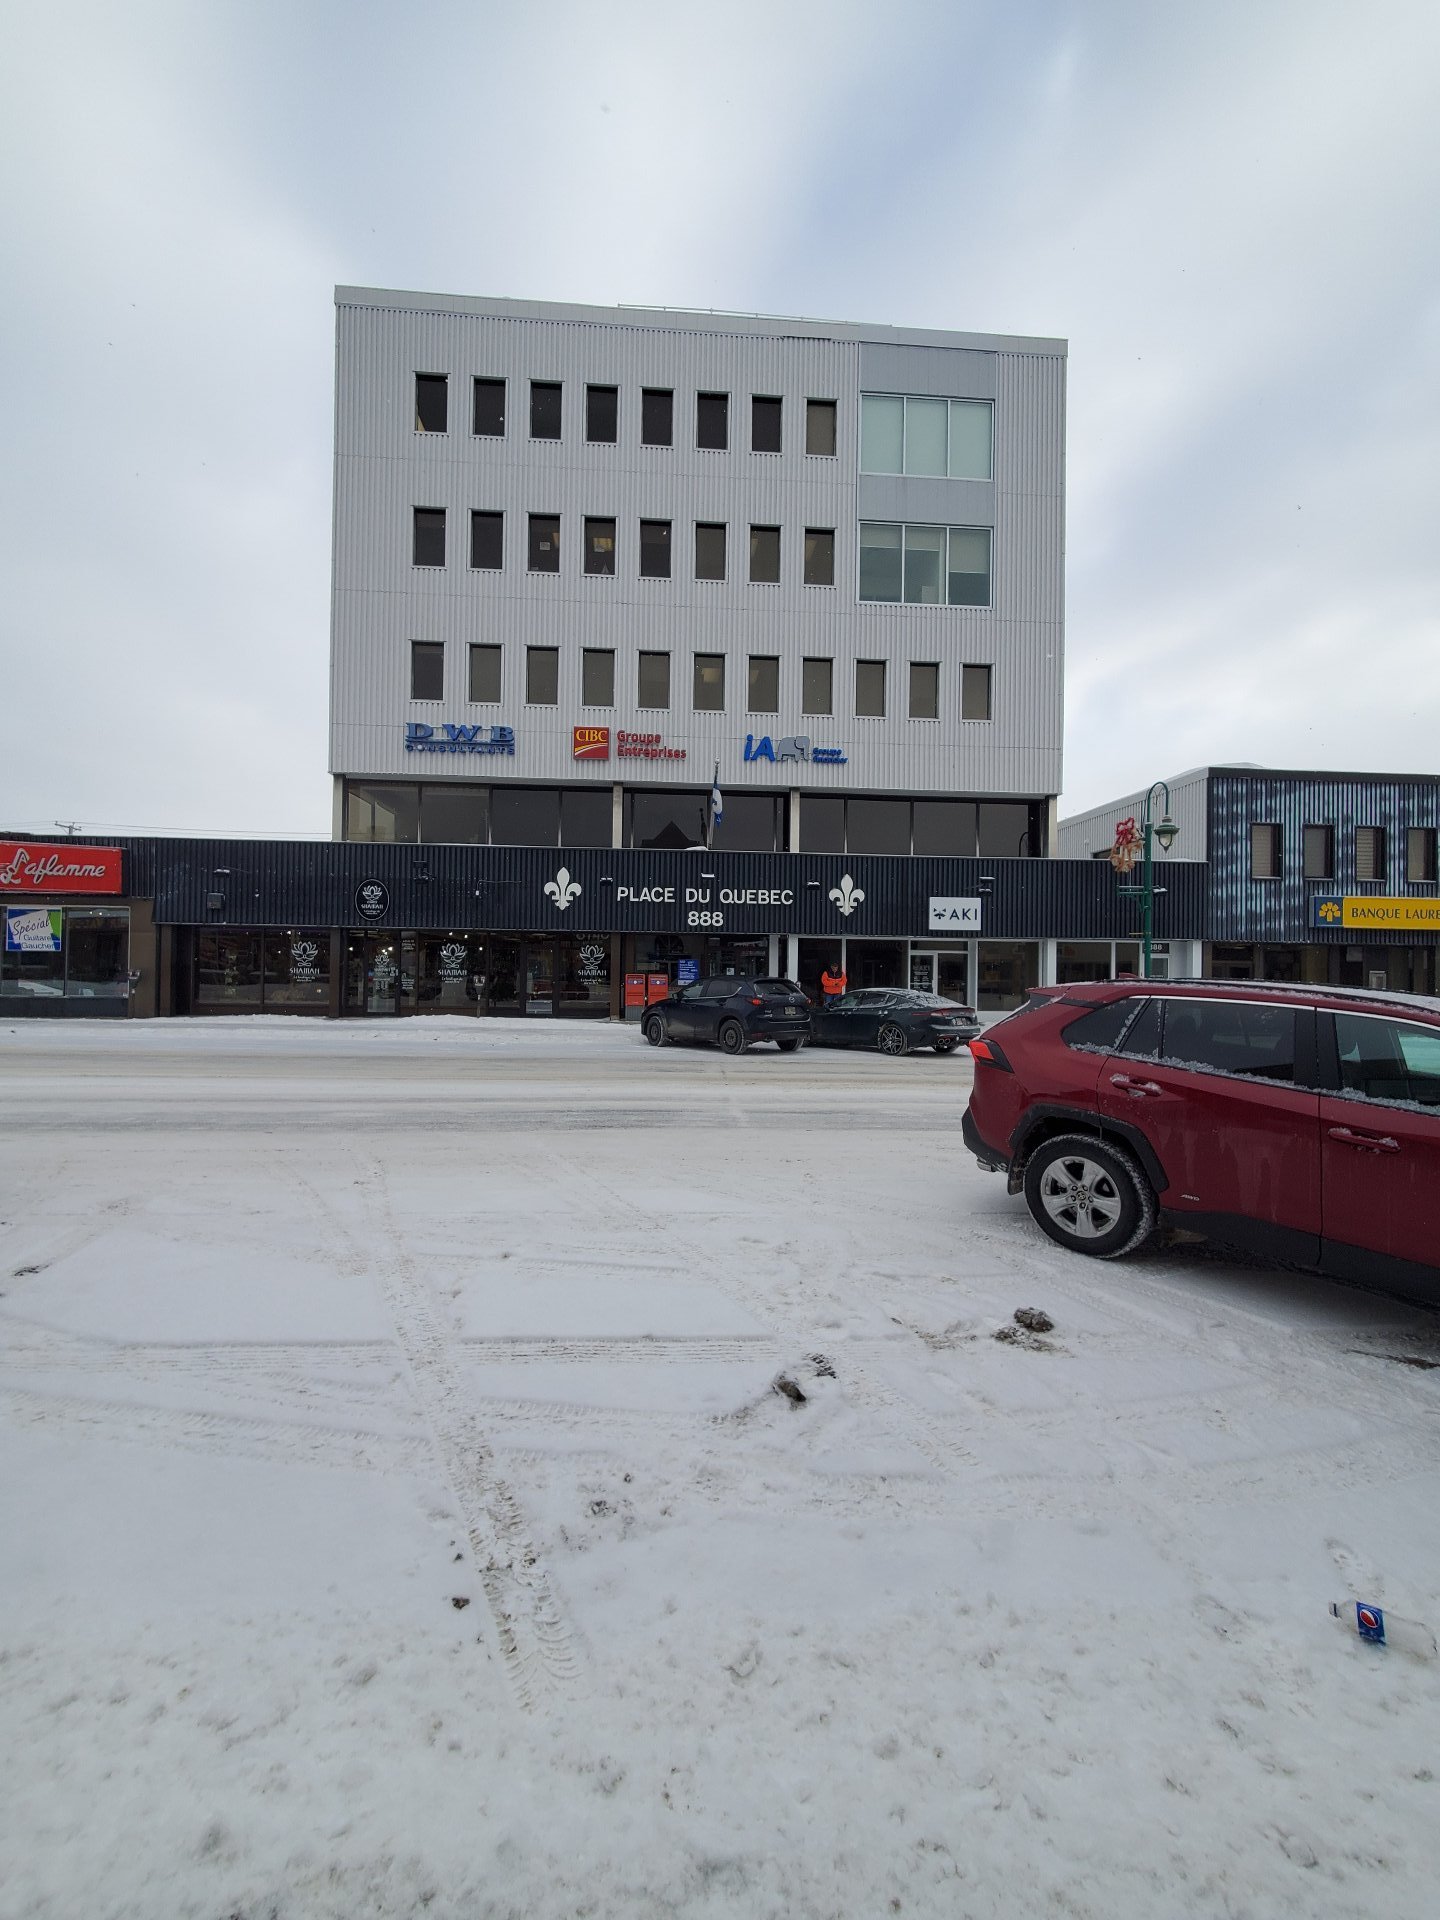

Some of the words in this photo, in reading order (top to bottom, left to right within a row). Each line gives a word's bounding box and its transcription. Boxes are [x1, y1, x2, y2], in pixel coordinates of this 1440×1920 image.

[575, 729, 608, 742] CIBC
[616, 730, 662, 745] Groupe
[405, 743, 515, 756] CONSULTANTS
[616, 744, 687, 760] Entreprises
[812, 747, 843, 757] Groupe
[0, 848, 106, 884] Laflamme
[616, 887, 676, 903] PLACE
[685, 888, 711, 904] DU
[719, 888, 794, 905] QUEBEC
[687, 911, 724, 927] 888
[949, 907, 978, 921] AKI
[1351, 907, 1401, 920] BANQUE
[13, 912, 50, 941] Spécial
